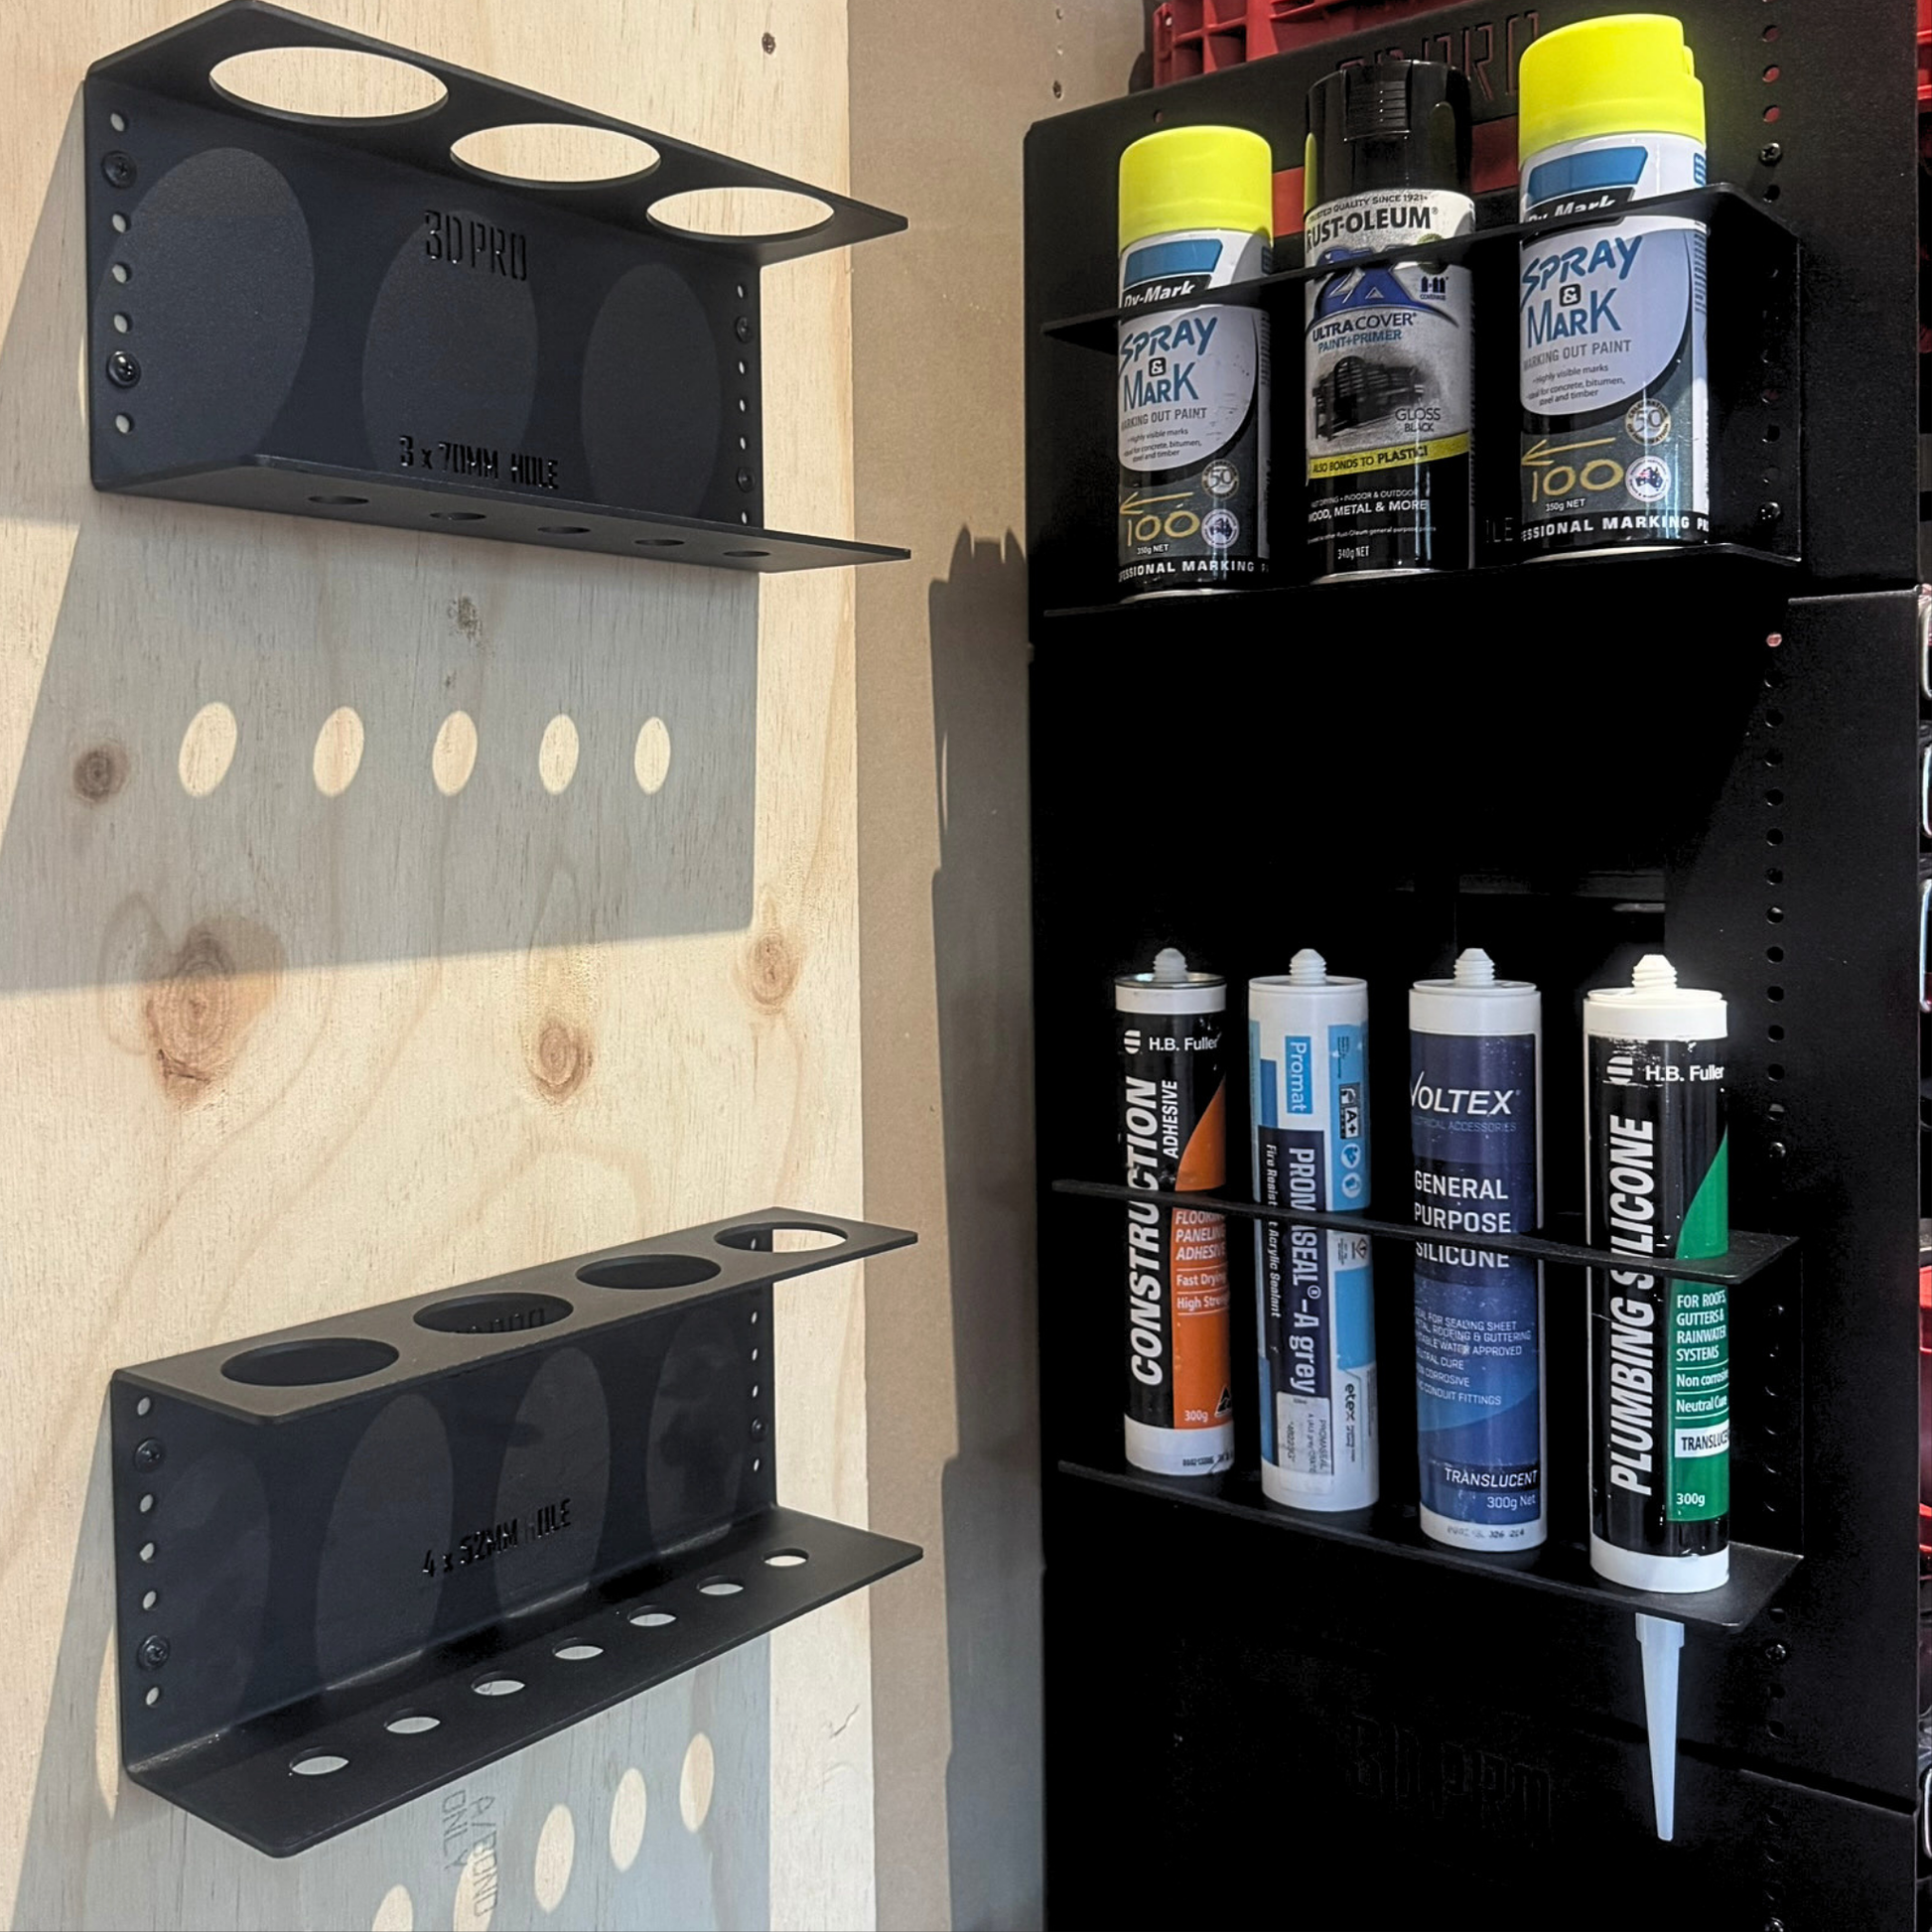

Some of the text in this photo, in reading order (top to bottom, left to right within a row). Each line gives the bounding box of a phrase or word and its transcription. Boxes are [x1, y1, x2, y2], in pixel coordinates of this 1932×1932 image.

[1333, 198, 1371, 212] QUALITY
[1372, 195, 1401, 205] SINCE
[1520, 234, 1643, 312] SPRAY
[1562, 286, 1578, 304] &
[1119, 316, 1218, 376] SPRAY
[1317, 329, 1403, 353] PAINT+PRIMER
[1562, 344, 1587, 360] OUT
[1591, 339, 1632, 355] PAINT
[1151, 358, 1164, 374] &
[1557, 366, 1582, 380] visible
[1583, 363, 1609, 374] marks
[1540, 386, 1550, 397] for
[1586, 376, 1626, 388] bitumen,
[1554, 391, 1569, 402] and
[1570, 388, 1598, 399] timber
[1151, 409, 1172, 426] OUT
[1174, 407, 1208, 421] PAINT
[1395, 407, 1442, 421] GLOSS
[1146, 429, 1167, 440] visible
[1167, 428, 1189, 437] marks
[1404, 422, 1435, 433] BLACK
[399, 435, 414, 468] 3
[510, 453, 559, 489] HOLE
[1145, 451, 1157, 460] and
[1157, 449, 1180, 459] timber
[1329, 460, 1358, 472] BONDS
[1359, 456, 1375, 467] TO
[1377, 445, 1429, 465] PLASTIC!
[1531, 458, 1624, 503] 100
[1333, 501, 1373, 518] METAL
[1375, 501, 1386, 512] &
[1388, 499, 1430, 512] MORE
[1545, 497, 1587, 513] 350g NET
[1127, 509, 1201, 547] 100
[1601, 515, 1691, 532] MARKING
[1153, 543, 1170, 554] NET
[1355, 545, 1370, 558] NET
[1181, 559, 1255, 573] MARKING
[1149, 1035, 1218, 1052] H.B. Fuller
[1291, 1041, 1308, 1112] Promat
[1644, 1063, 1725, 1082] H.B. Fuller
[1410, 1070, 1515, 1116] VOLTEX
[1161, 1079, 1179, 1160] ADHESIVE
[1346, 1109, 1358, 1134] A+
[1448, 1120, 1517, 1134] ACCESSORIES
[1415, 1170, 1509, 1200] GENERAL
[1415, 1201, 1512, 1234] PURPOSE
[1125, 1074, 1164, 1386] CONSTRUCTION
[1265, 1144, 1282, 1318] Fire Resistt Acrylic Sealant
[1415, 1241, 1510, 1269] SILICONE
[1176, 1274, 1199, 1287] Fast
[1176, 1296, 1202, 1311] High
[1609, 1114, 1655, 1497] PLUMBING SILICONE
[1676, 1294, 1700, 1309] FOR
[1428, 1311, 1444, 1325] FOR
[1445, 1316, 1485, 1331] SEALING
[1486, 1320, 1517, 1332] SHEET
[1676, 1309, 1720, 1326] GUTTERS
[1433, 1324, 1470, 1342] ROOFING
[1473, 1331, 1481, 1342] &
[1483, 1329, 1532, 1343] GUTTERING
[1676, 1324, 1726, 1344] RAINWATER
[1472, 1344, 1522, 1357] APPROVED
[1676, 1345, 1720, 1362] SYSTEMS
[1289, 1335, 1316, 1394] grey
[1441, 1356, 1464, 1371] CURE
[1426, 1367, 1470, 1388] CORROSIVE
[1676, 1373, 1700, 1388] Non
[1344, 1383, 1357, 1422] etex
[1424, 1382, 1457, 1401] CONDUIT
[1458, 1391, 1502, 1407] FITTINGS
[1676, 1397, 1715, 1414] Neutral
[1183, 1410, 1209, 1423] 300g
[1445, 1466, 1538, 1488] TRANSLUCENT
[1486, 1493, 1537, 1511] 300g Net
[1676, 1492, 1706, 1507] 300g
[422, 1549, 435, 1578] 4
[442, 1789, 469, 1870] ONLY
